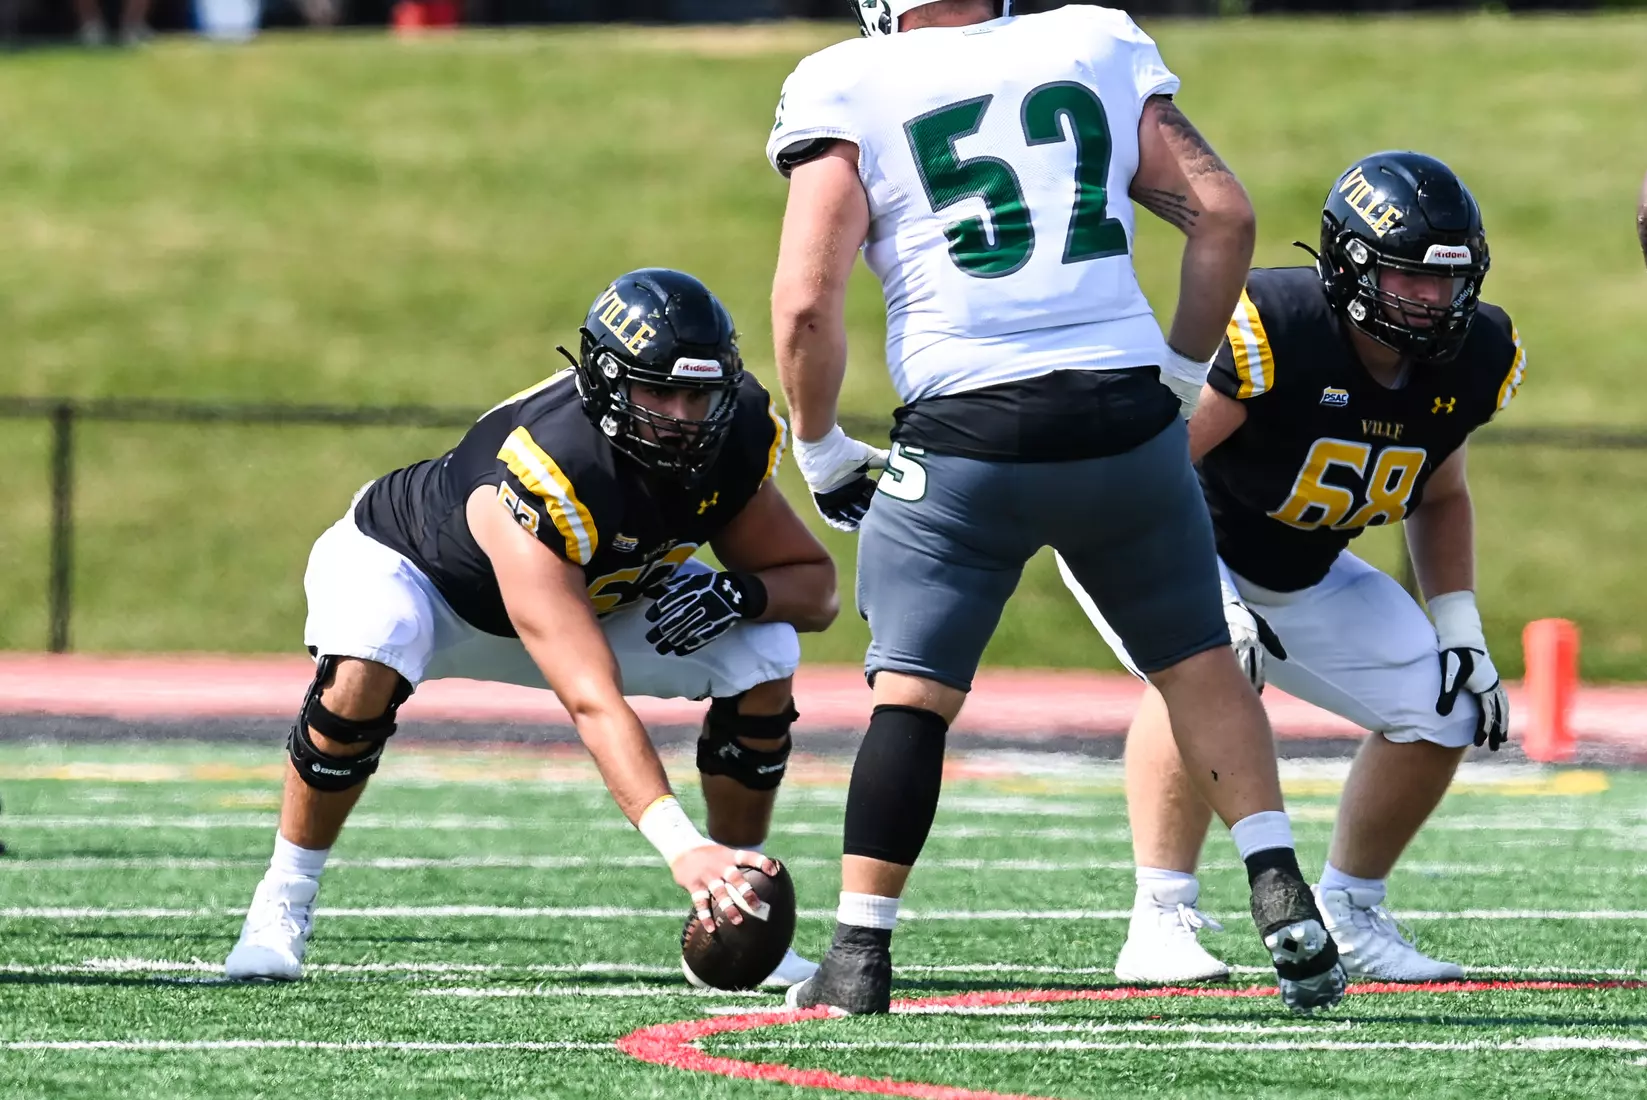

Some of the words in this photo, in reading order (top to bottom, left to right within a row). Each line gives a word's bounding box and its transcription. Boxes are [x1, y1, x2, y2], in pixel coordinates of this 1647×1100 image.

[902, 80, 1129, 278] 52
[1338, 166, 1402, 238] VILLE
[593, 284, 657, 356] VILLE
[1266, 437, 1427, 531] 68
